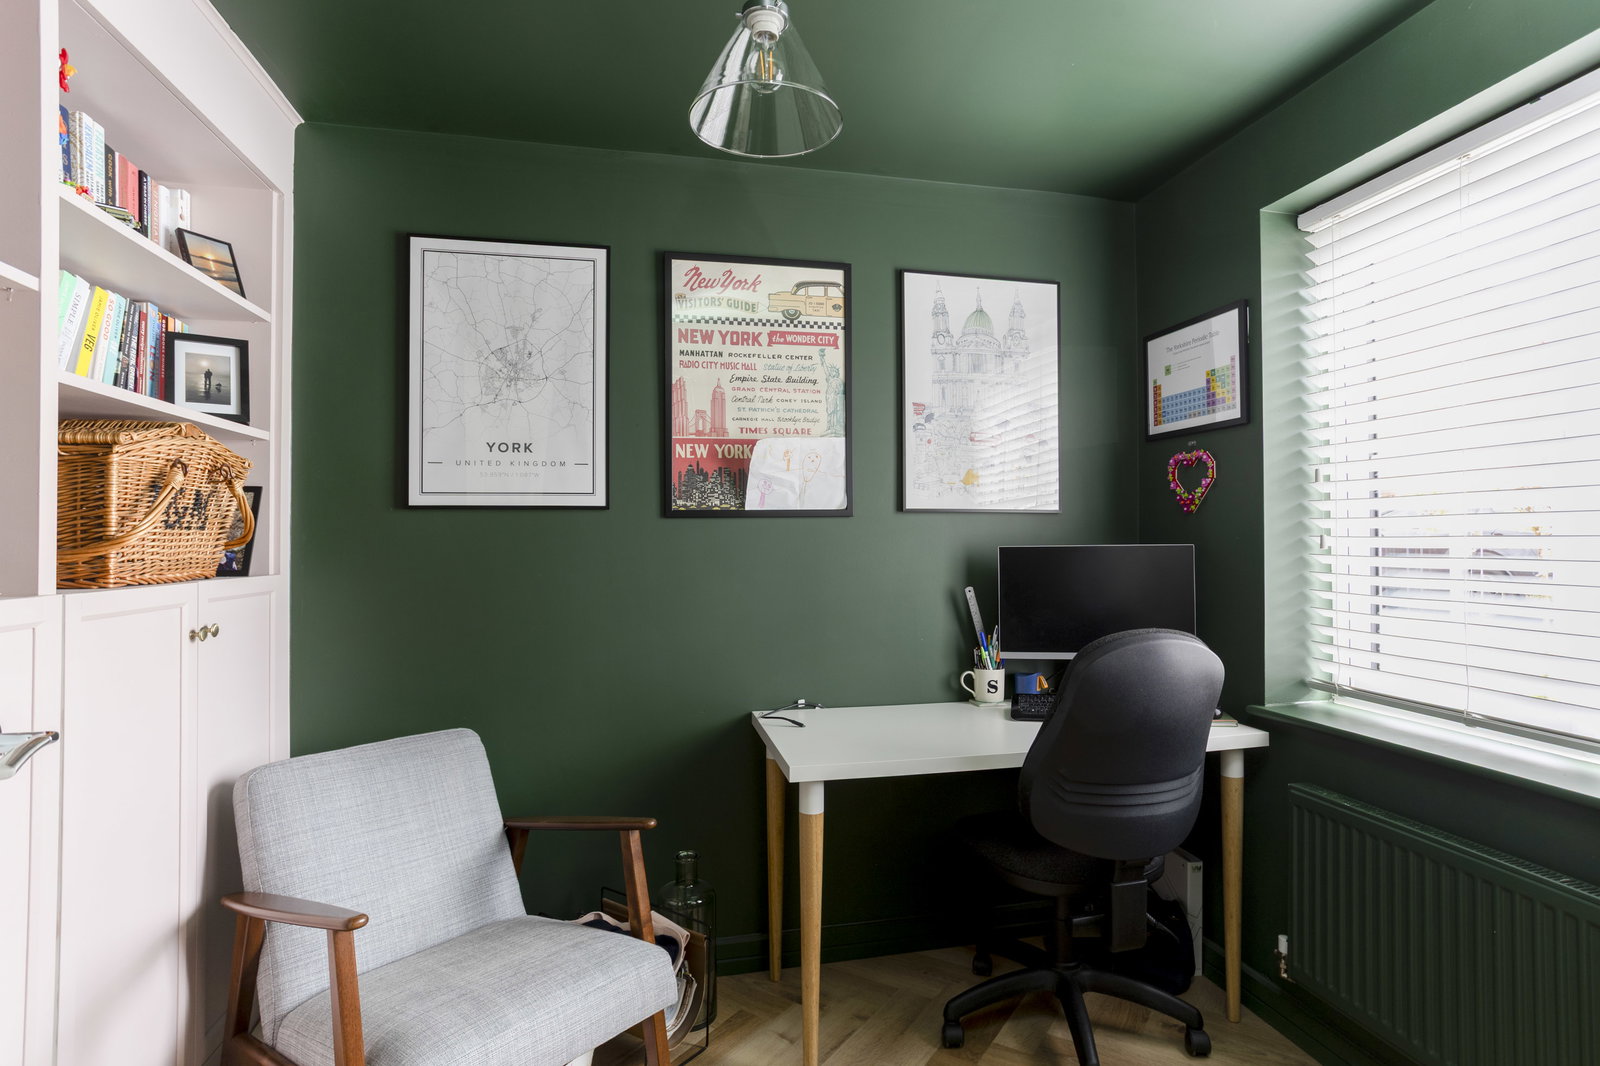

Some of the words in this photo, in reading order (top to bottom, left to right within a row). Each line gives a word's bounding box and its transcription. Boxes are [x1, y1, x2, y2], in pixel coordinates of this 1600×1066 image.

[84, 121, 94, 172] JERUSALEM
[684, 265, 720, 292] New
[717, 268, 762, 295] York
[67, 292, 81, 326] SIMPLE
[108, 299, 115, 312] SO
[677, 297, 724, 309] VISITORS'
[726, 298, 757, 312] GUIDE
[92, 310, 100, 331] OLIVER
[103, 313, 112, 341] GOOD
[83, 333, 97, 352] VEG
[678, 328, 715, 344] NEW
[718, 330, 763, 346] YORK
[772, 332, 784, 343] the
[786, 333, 816, 344] WONDER
[817, 335, 835, 345] CITY
[1173, 340, 1191, 351] Yorkshire
[1191, 334, 1208, 345] Periodic
[679, 350, 724, 358] MANHATTAN
[679, 360, 700, 369] RADIO
[701, 361, 719, 369] CITY
[720, 362, 740, 370] MUSIC
[741, 362, 757, 371] HALL
[763, 363, 785, 371] Statue
[785, 364, 793, 373] of
[793, 363, 818, 373] Liberty
[729, 374, 758, 383] Empire
[761, 374, 783, 383] State
[785, 375, 819, 385] Building
[731, 394, 757, 403] Central
[758, 395, 774, 403] Park
[738, 427, 768, 435] TIMES
[773, 427, 812, 436] SQUARE
[486, 442, 533, 453] YORK
[675, 444, 713, 459] NEW
[714, 444, 752, 459] YORK
[455, 459, 502, 467] UNITED
[509, 460, 567, 468] KINGDOM
[987, 680, 998, 693] S
